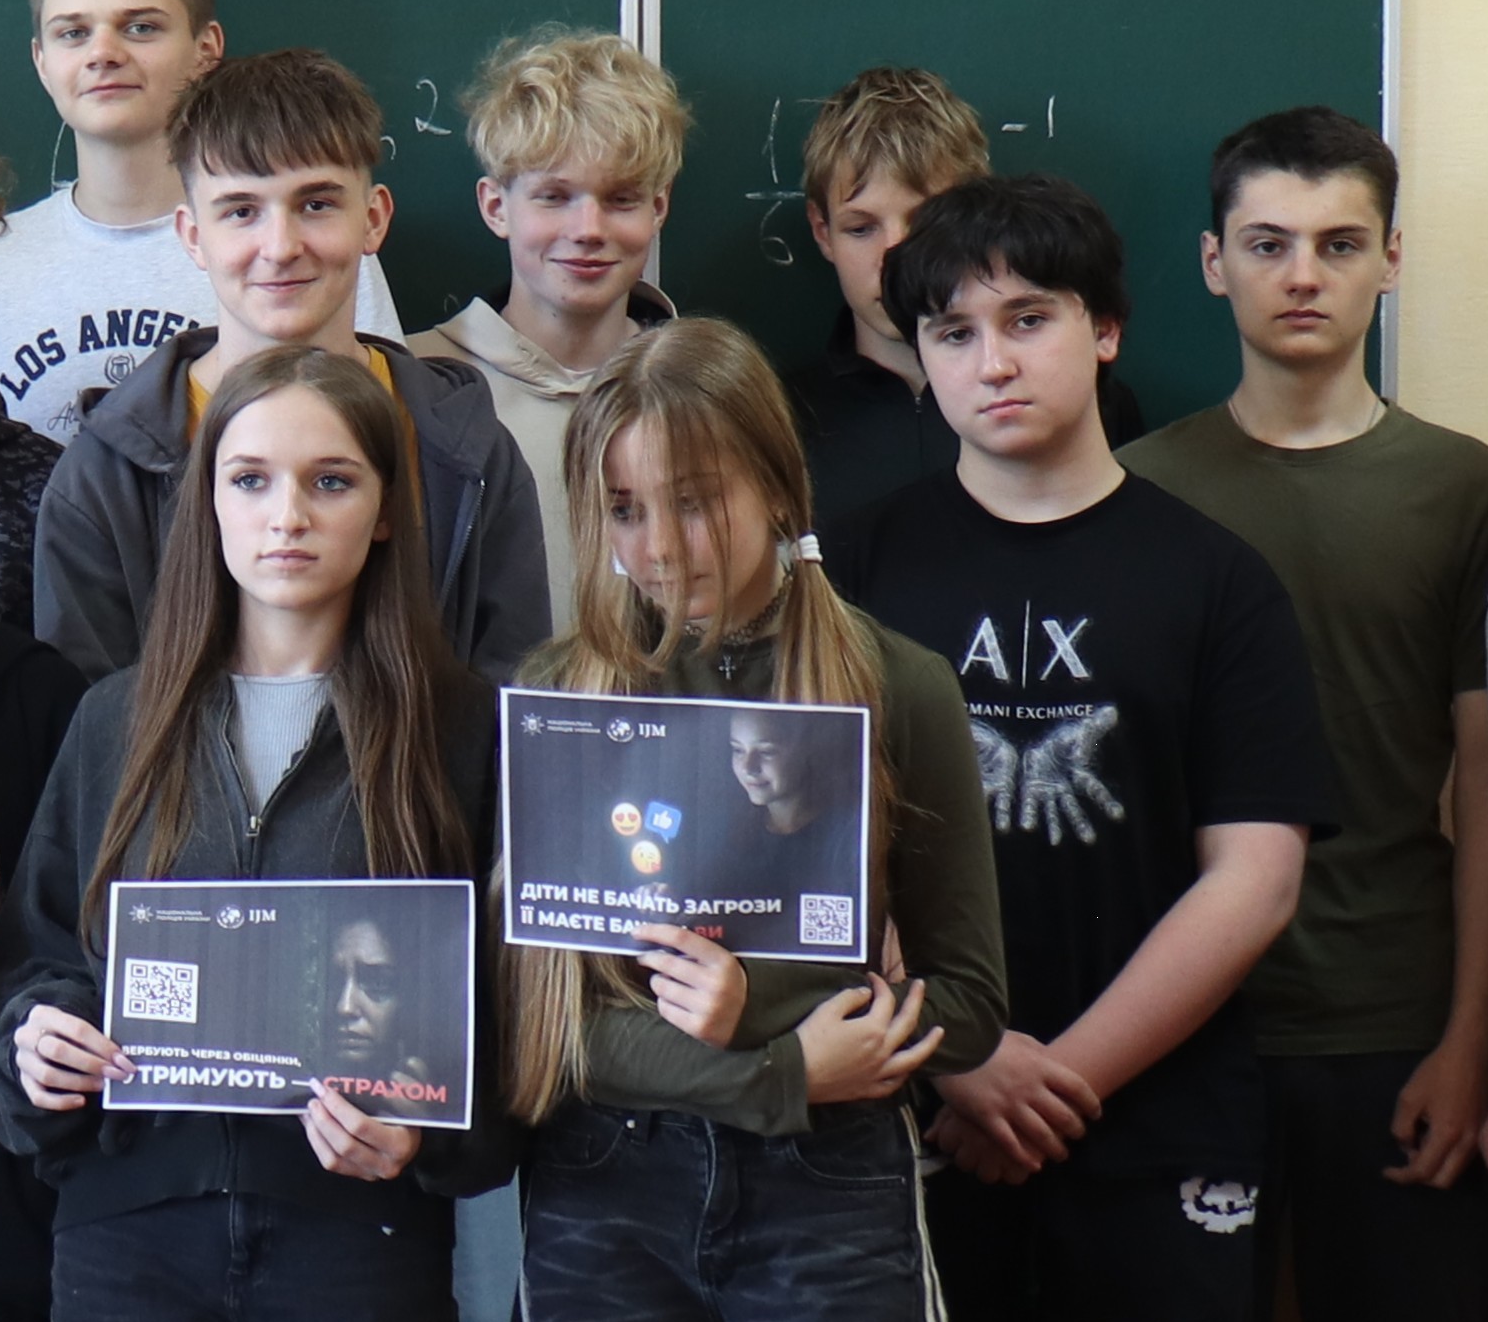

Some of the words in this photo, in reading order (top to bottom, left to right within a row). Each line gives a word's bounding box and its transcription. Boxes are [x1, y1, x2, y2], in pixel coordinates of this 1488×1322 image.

[0, 328, 67, 402] LOS
[78, 308, 201, 354] ANGE
[964, 701, 1011, 718] MANI
[1015, 703, 1095, 720] EXCHANGE
[637, 722, 667, 739] IJM
[520, 882, 568, 904] ДІТИ
[573, 886, 599, 906] НЕ
[603, 888, 680, 916] БАЧАТЬ
[683, 897, 783, 916] ЗАГРОЗИ
[248, 909, 277, 924] IJM
[519, 906, 535, 925] ЇЇ
[537, 910, 606, 933] МАЄТЕ
[191, 1047, 232, 1062] ЧЕРЕЗ
[233, 1050, 303, 1069] ОБІЦЯНКИ,
[323, 1074, 449, 1105] СТРАХОМ
